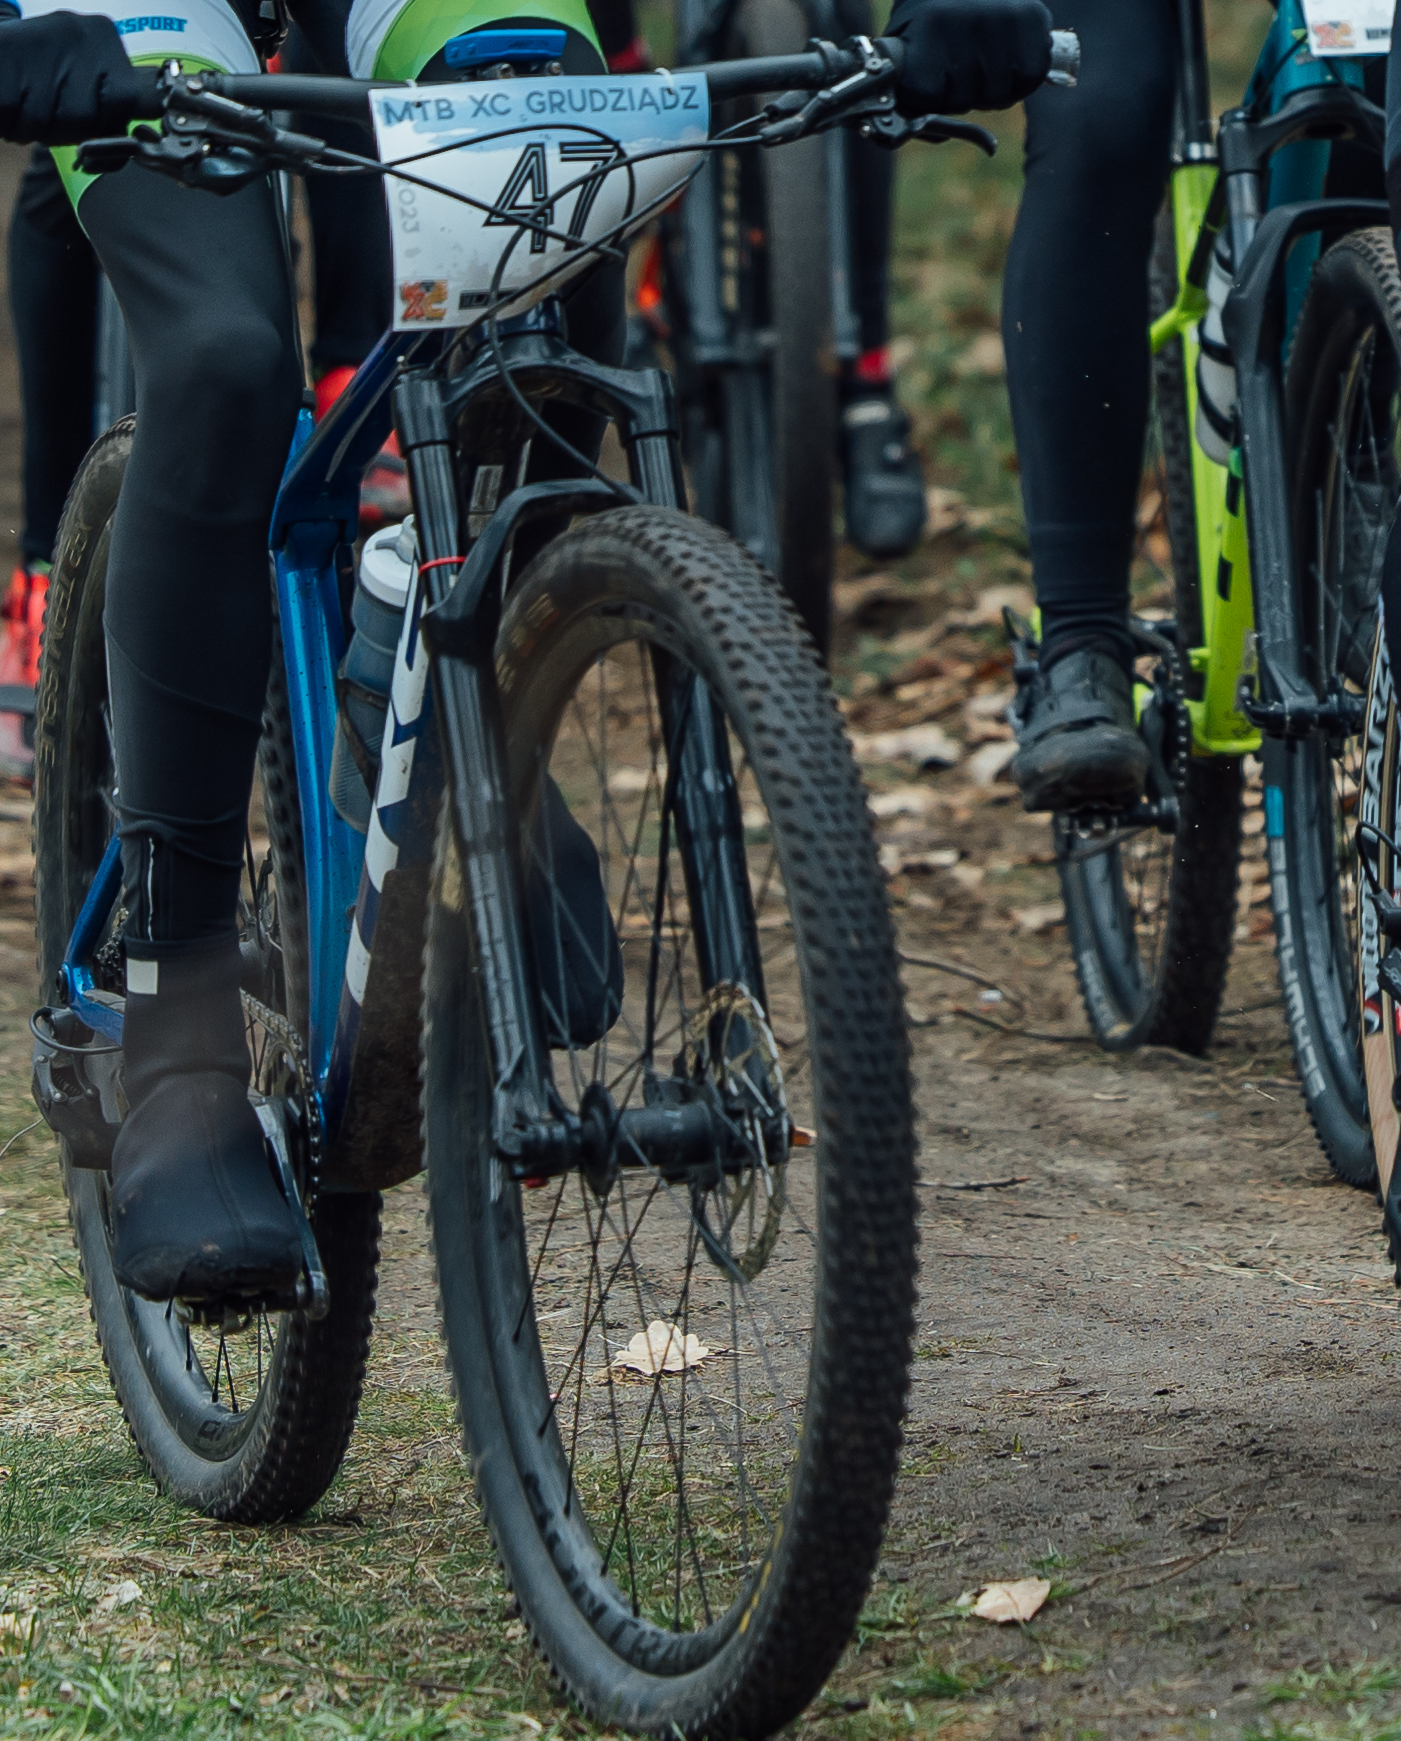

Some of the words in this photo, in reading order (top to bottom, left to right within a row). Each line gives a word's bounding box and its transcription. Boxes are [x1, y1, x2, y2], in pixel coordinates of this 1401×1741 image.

[383, 98, 455, 125] MTB
[469, 92, 513, 118] XC
[526, 85, 699, 116] GRUDZIĄDZ
[483, 141, 623, 254] 47
